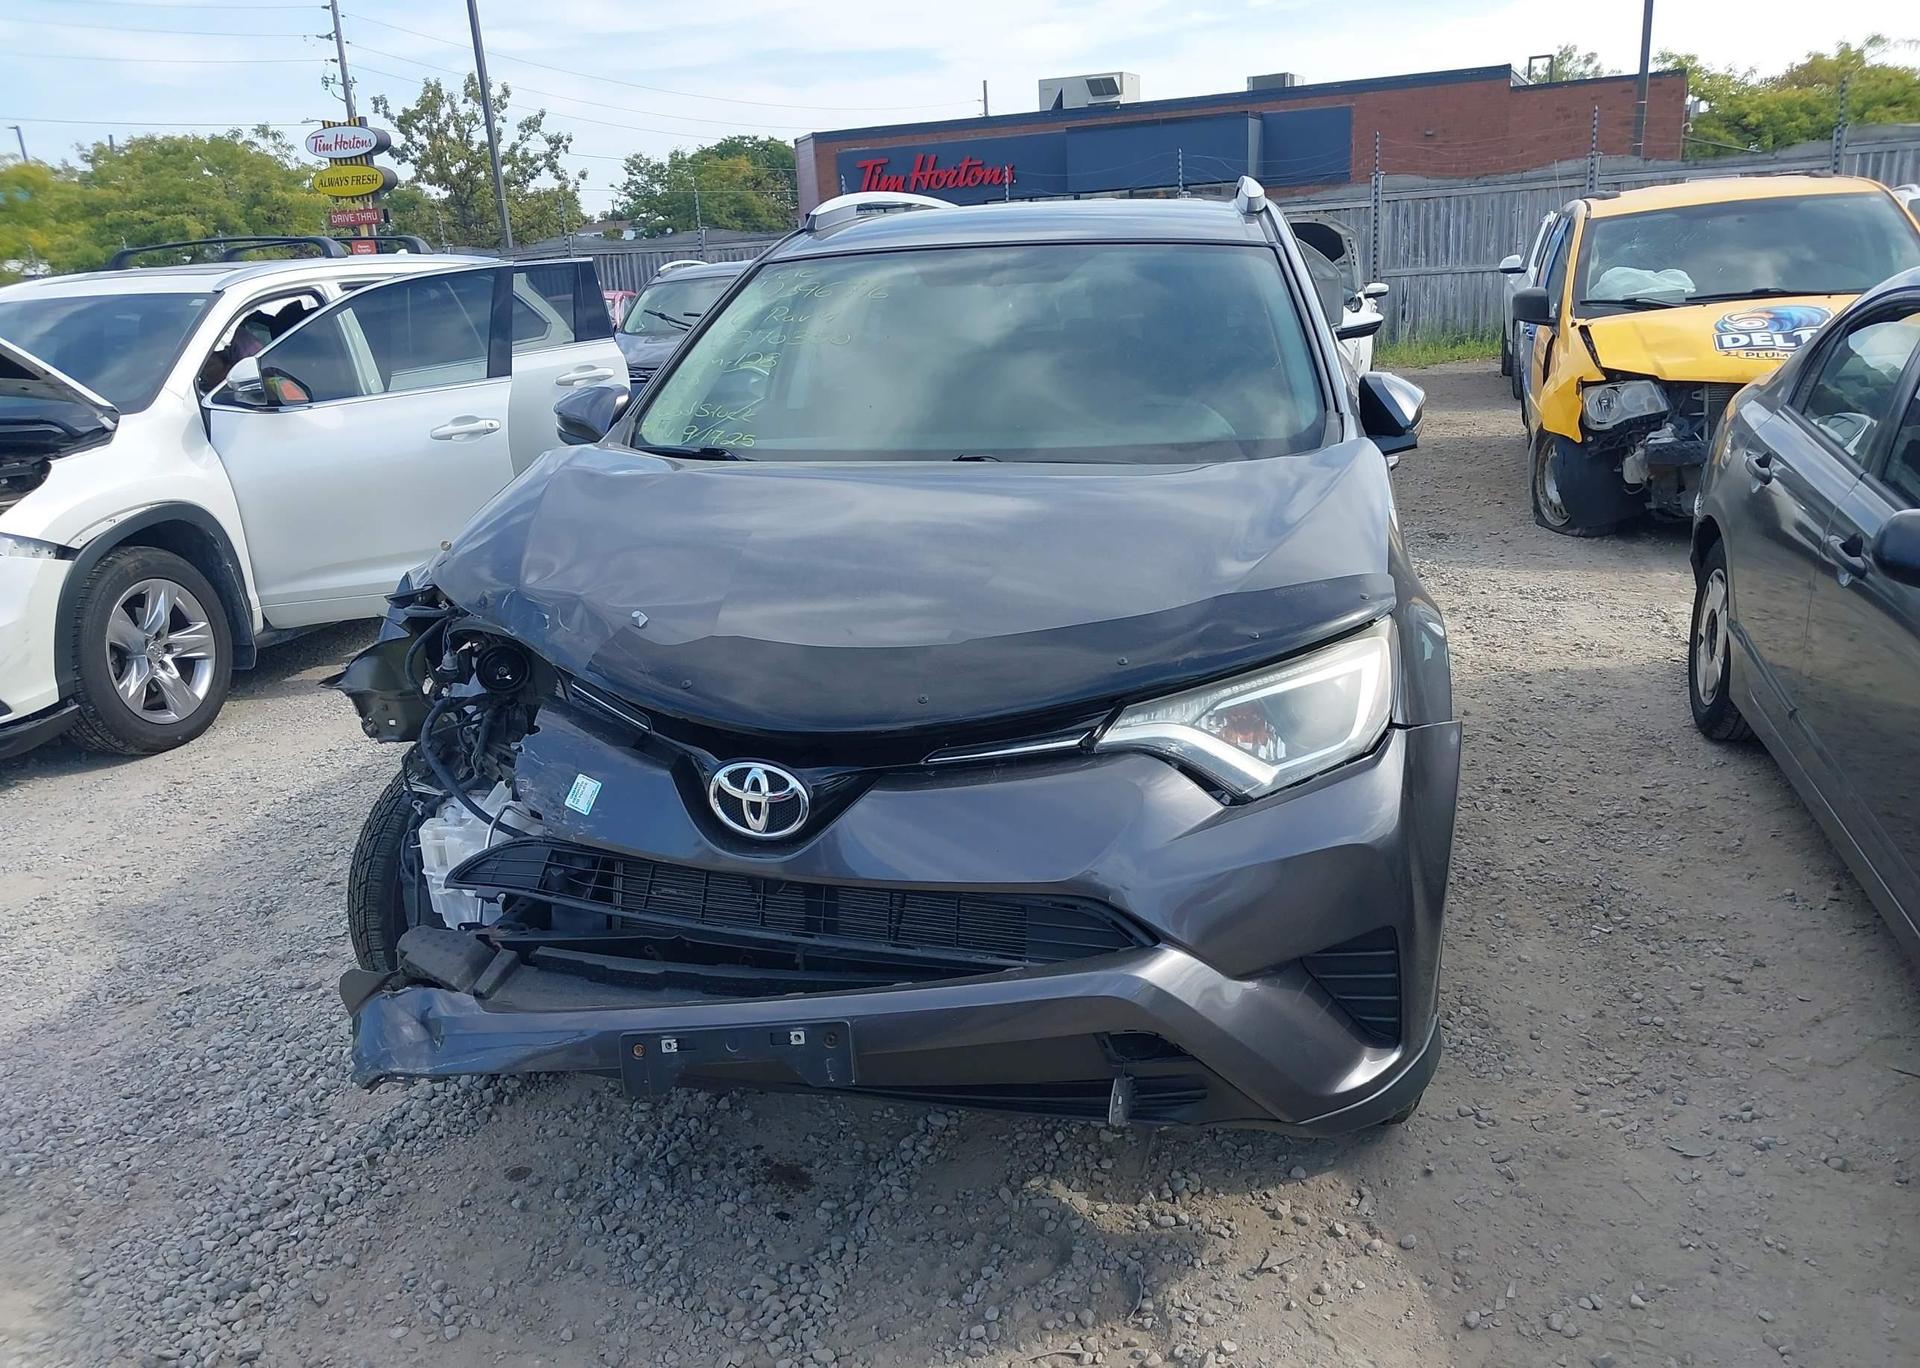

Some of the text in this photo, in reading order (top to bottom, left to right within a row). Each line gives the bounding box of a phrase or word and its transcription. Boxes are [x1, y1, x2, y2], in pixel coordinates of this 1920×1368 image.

[311, 133, 373, 153] Tim Hortons
[317, 174, 378, 188] ALWAYS FRESH
[856, 152, 1015, 193] Tim Hortons
[331, 211, 378, 223] DRIVE THRU
